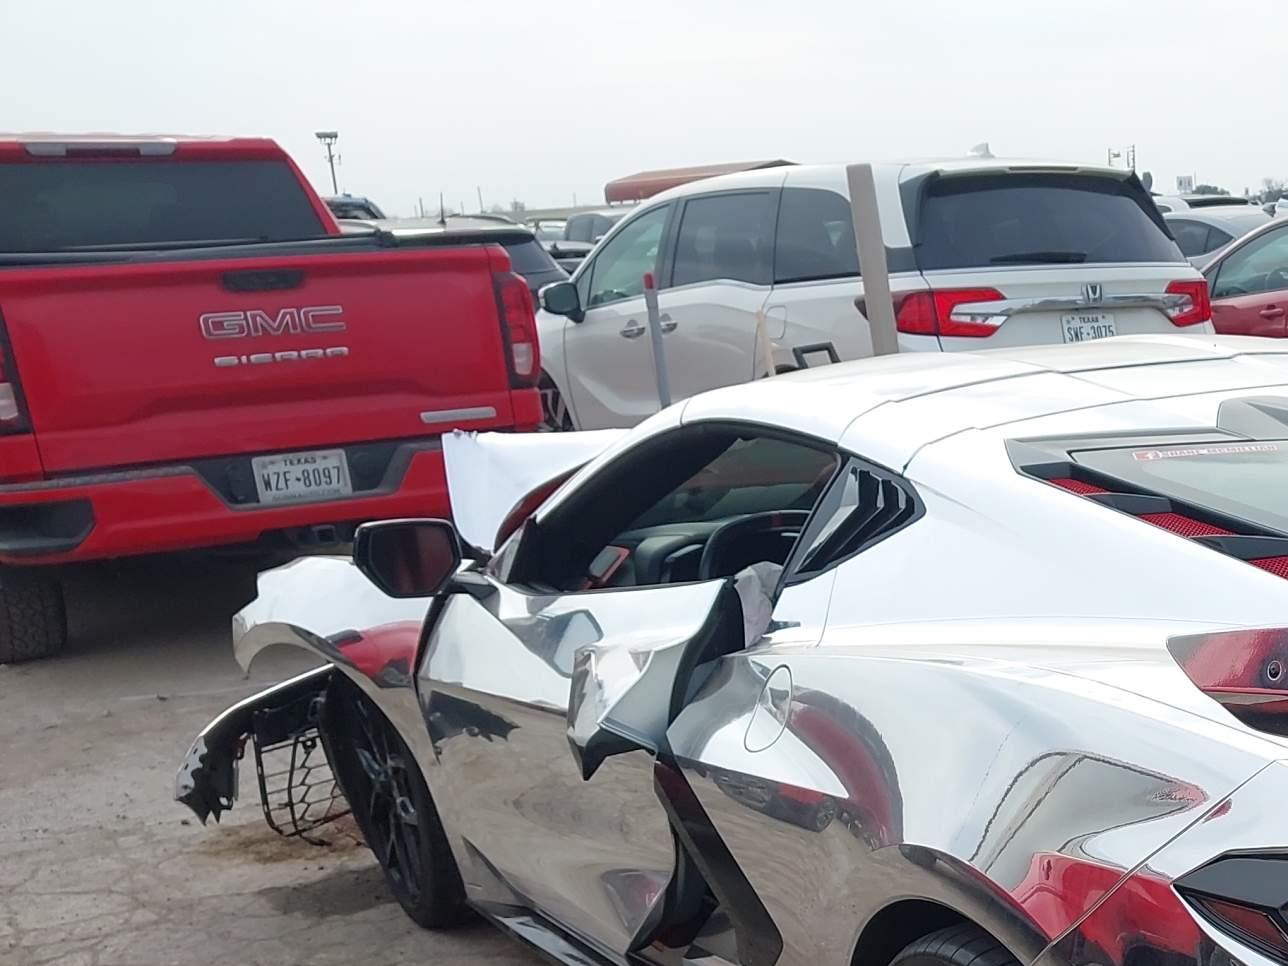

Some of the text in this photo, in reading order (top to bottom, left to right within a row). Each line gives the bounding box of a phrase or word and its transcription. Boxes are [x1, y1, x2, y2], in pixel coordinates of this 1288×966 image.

[200, 305, 346, 338] GMC
[214, 346, 349, 367] SIERRA
[283, 456, 317, 466] TEXAS
